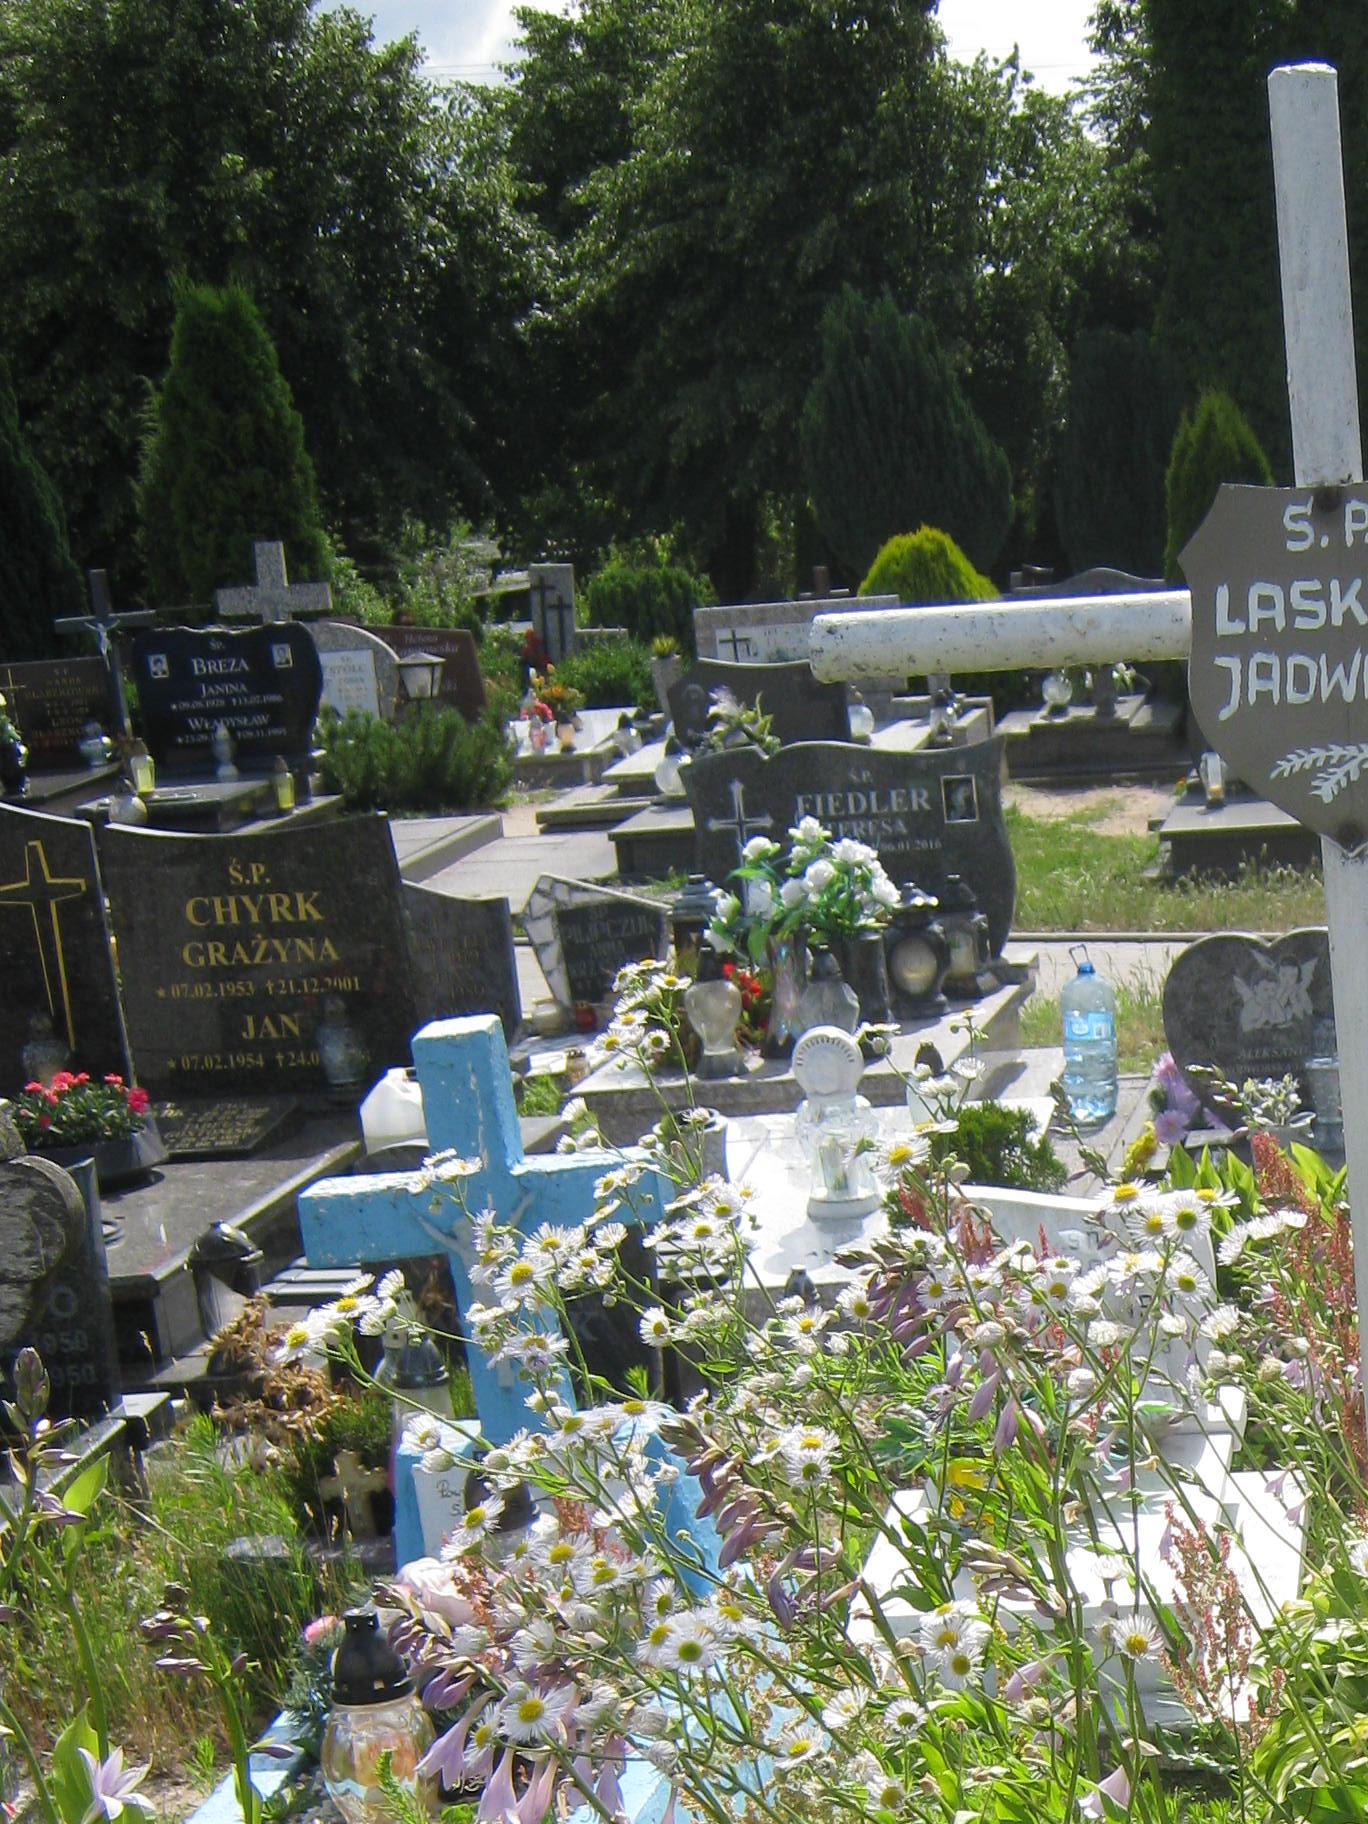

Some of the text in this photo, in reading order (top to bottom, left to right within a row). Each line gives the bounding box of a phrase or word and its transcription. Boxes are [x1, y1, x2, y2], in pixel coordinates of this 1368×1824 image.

[192, 657, 249, 675] BREZA
[201, 683, 248, 698] JANINA
[796, 787, 931, 817] FIEDLER
[185, 891, 325, 927] CHYRK
[181, 933, 341, 968] GRAŻYNA
[171, 980, 254, 999] 07.02.1953
[241, 1013, 300, 1040] JAN
[181, 1052, 265, 1071] 07.02.1954
